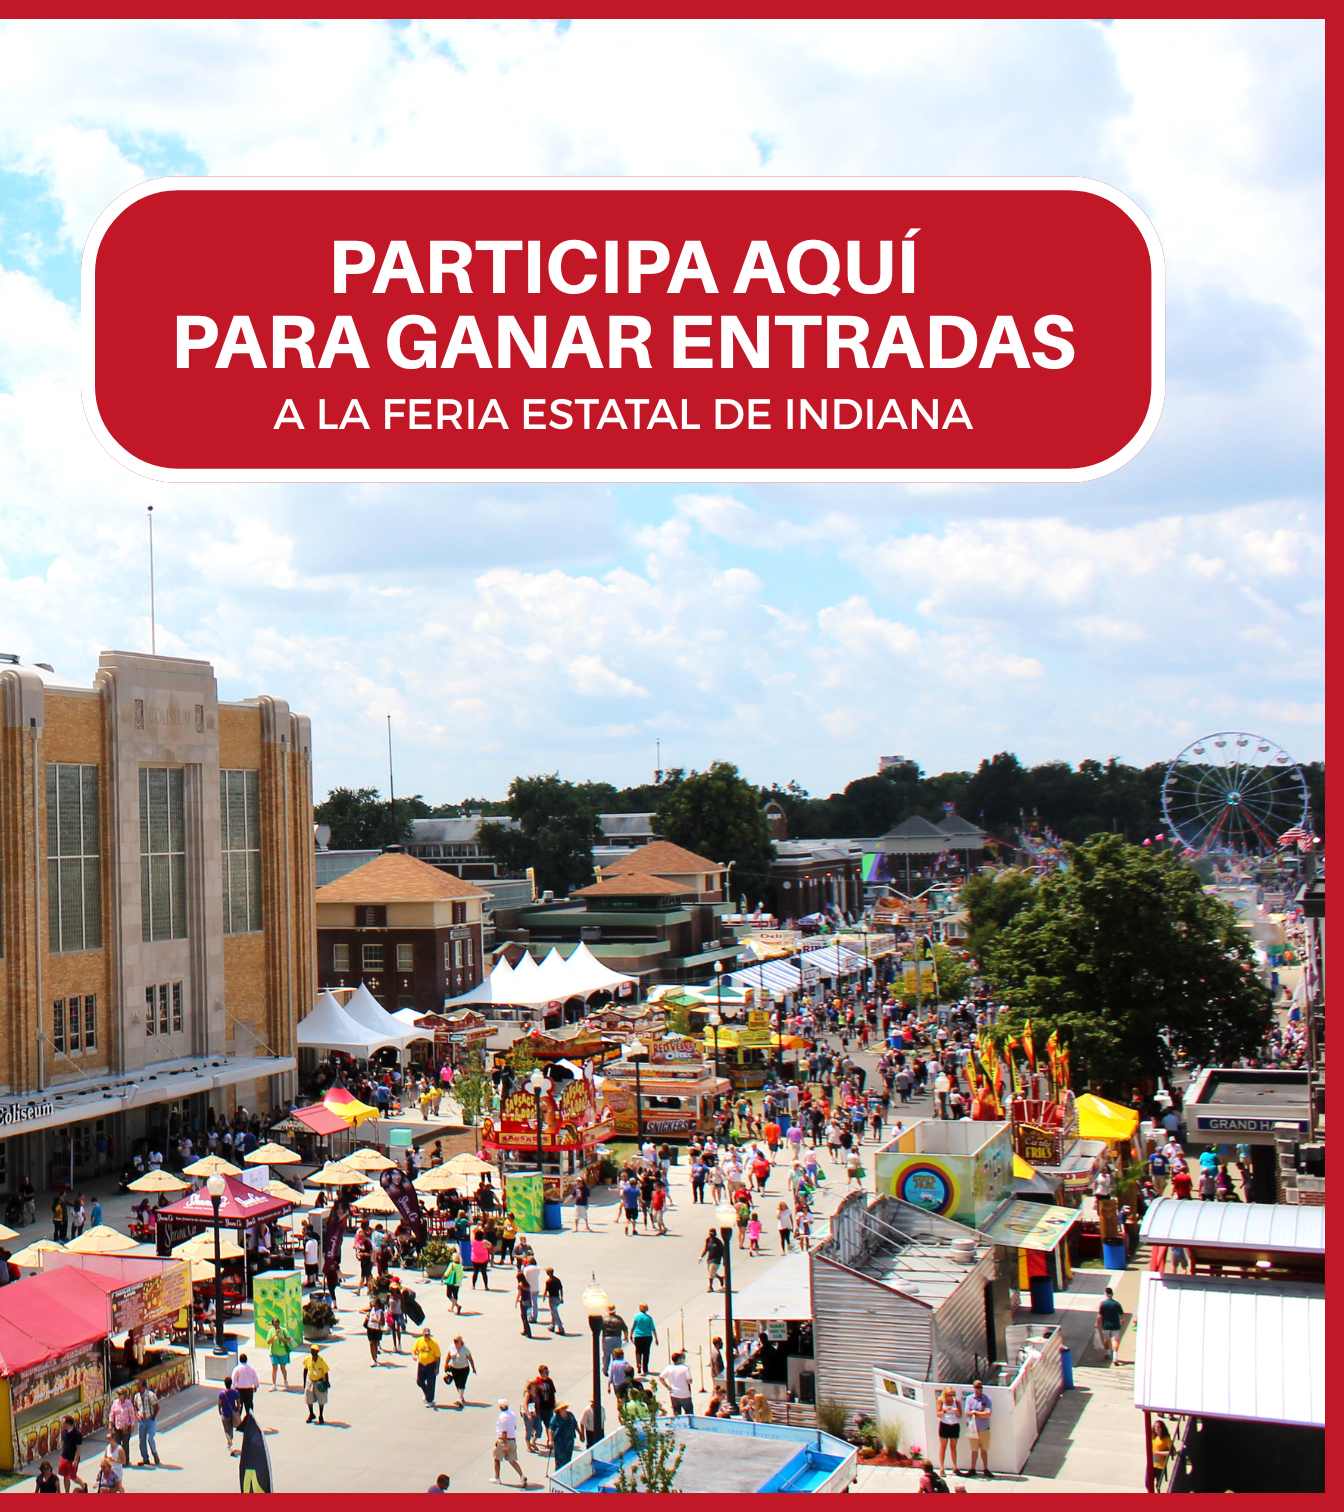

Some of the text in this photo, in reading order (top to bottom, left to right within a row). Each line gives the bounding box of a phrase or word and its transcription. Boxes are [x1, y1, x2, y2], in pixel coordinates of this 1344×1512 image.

[646, 1119, 689, 1134] SNICKERS
[1209, 1118, 1276, 1131] GRAND HA
[1025, 1147, 1053, 1159] FRIES
[185, 1193, 214, 1208] Shan
